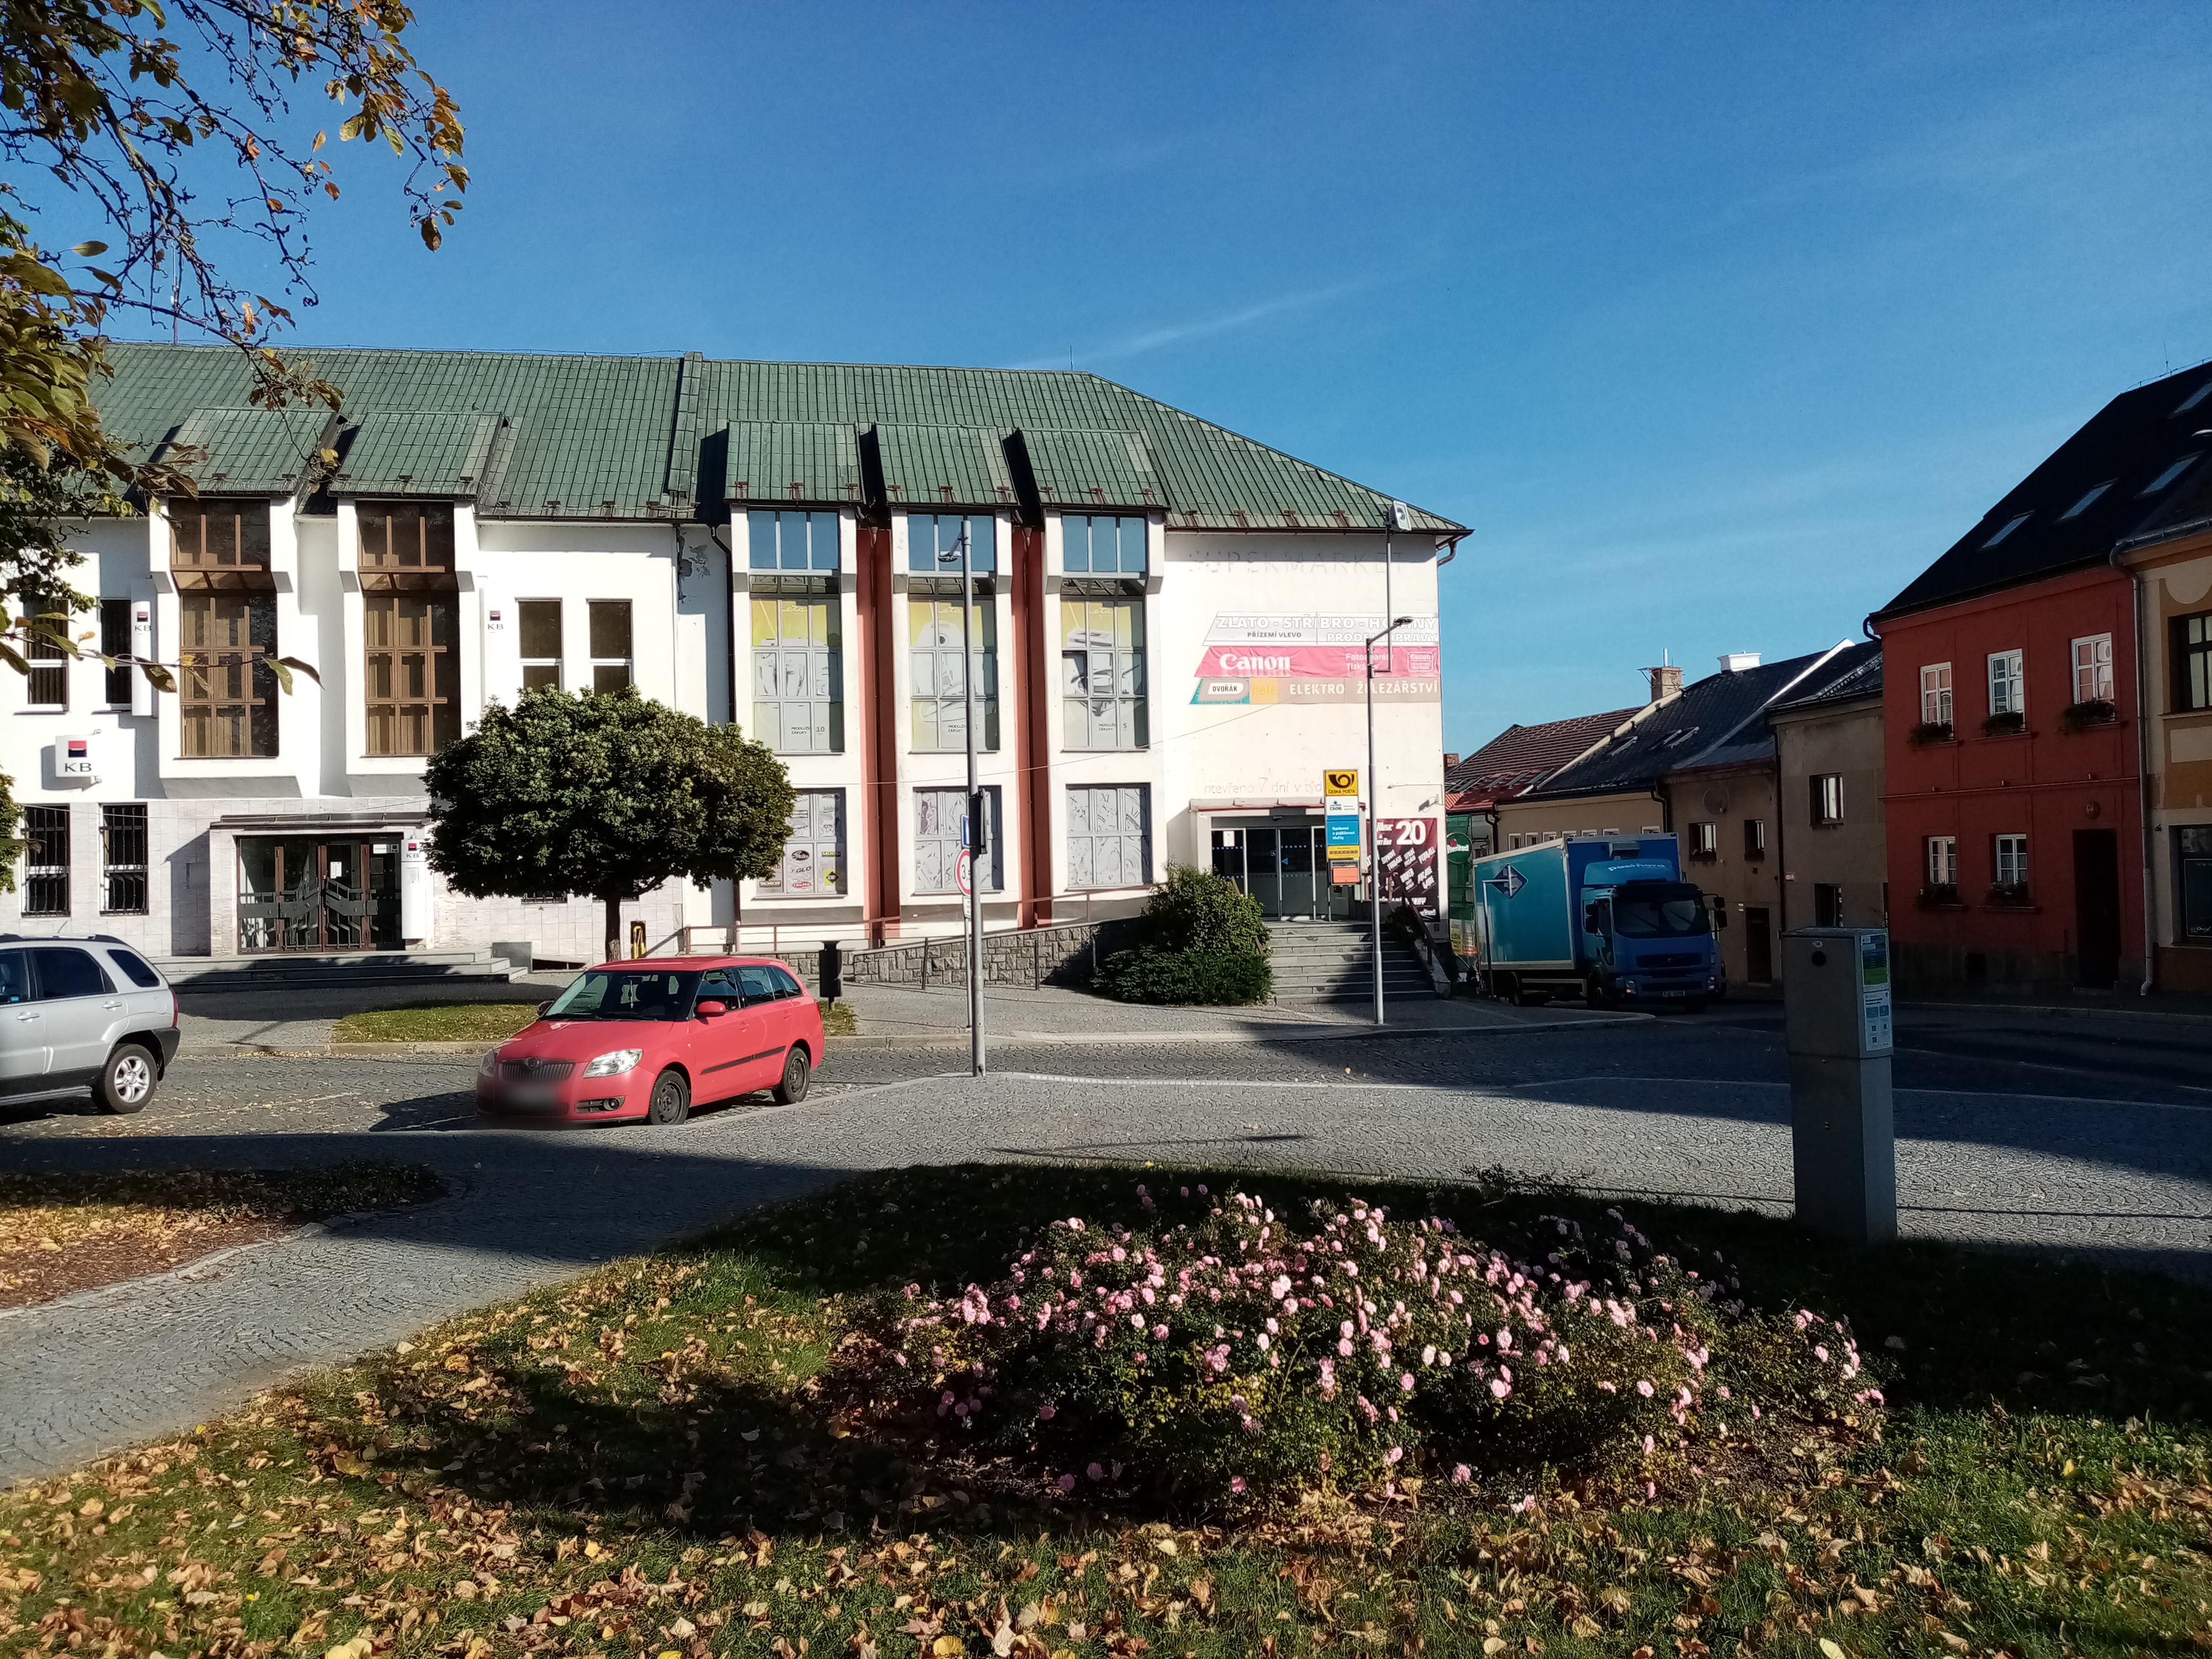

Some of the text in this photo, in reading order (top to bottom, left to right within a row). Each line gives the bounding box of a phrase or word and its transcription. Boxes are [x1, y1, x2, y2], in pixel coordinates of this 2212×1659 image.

[1217, 617, 1270, 629] ZLATO
[1282, 614, 1354, 629] STŘÍBRO
[1219, 653, 1291, 670] Canon
[1290, 684, 1345, 695] ELEKTRO
[65, 763, 92, 773] KB
[1258, 778, 1269, 792] 7
[1396, 820, 1426, 845] 20
